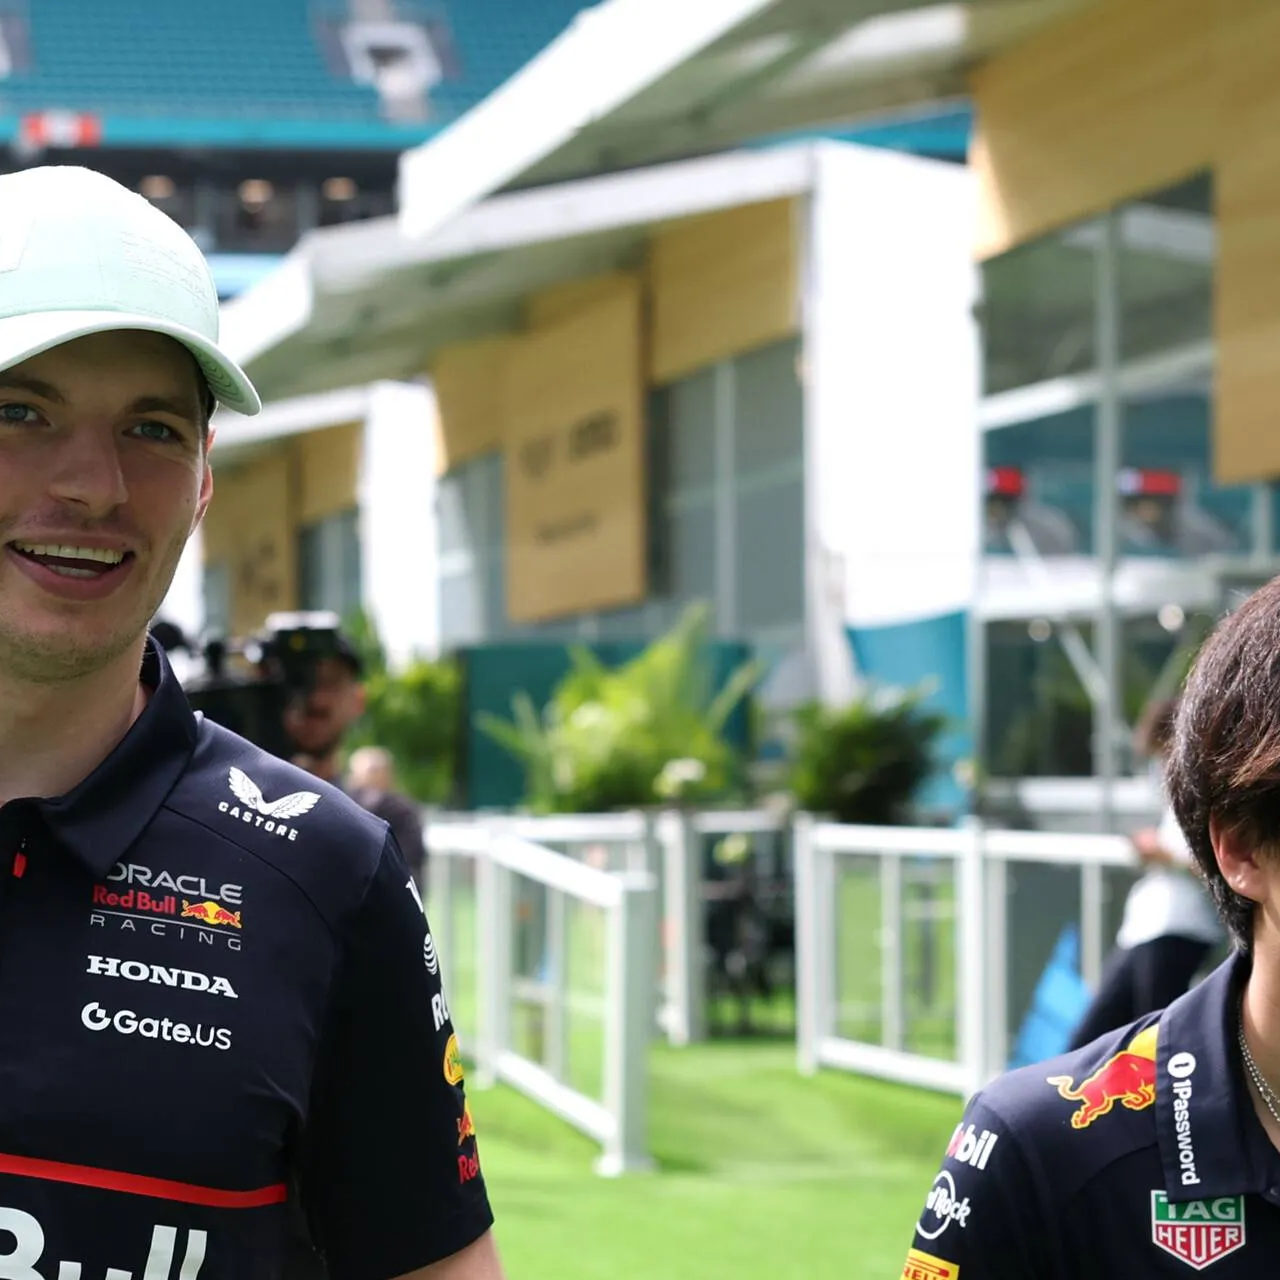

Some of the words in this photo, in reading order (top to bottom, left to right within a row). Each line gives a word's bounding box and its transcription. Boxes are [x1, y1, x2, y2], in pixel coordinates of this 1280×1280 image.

[218, 801, 298, 842] CASTORE
[92, 884, 134, 909] Red
[136, 892, 177, 914] Bull
[90, 914, 242, 951] RACING
[87, 955, 238, 998] HONDA
[113, 1010, 232, 1050] Gate.US
[1173, 1079, 1201, 1186] 1Password
[1158, 1226, 1239, 1263] HEUER
